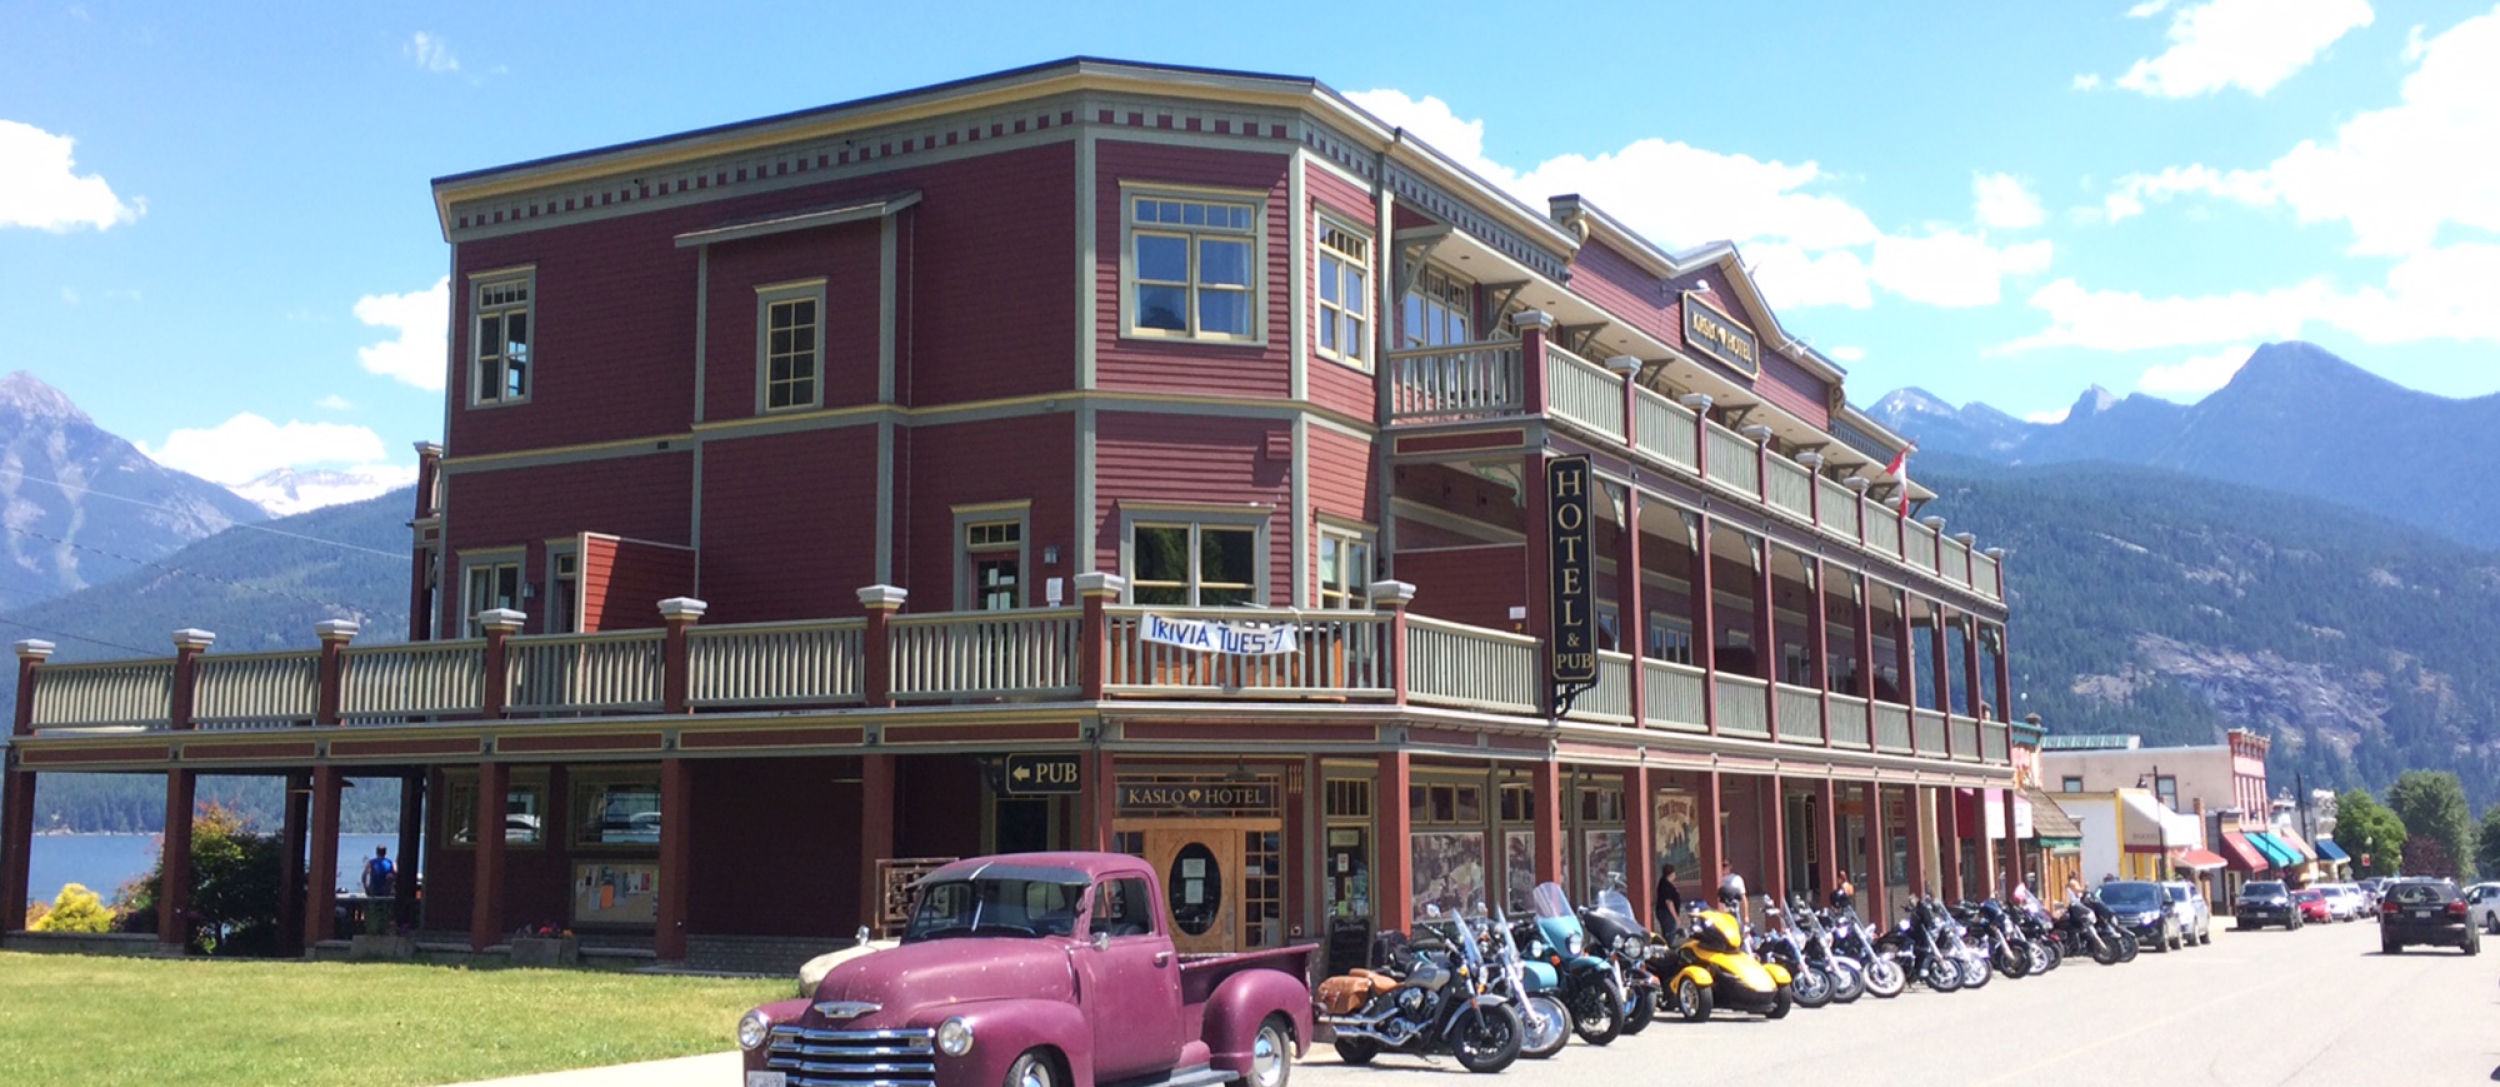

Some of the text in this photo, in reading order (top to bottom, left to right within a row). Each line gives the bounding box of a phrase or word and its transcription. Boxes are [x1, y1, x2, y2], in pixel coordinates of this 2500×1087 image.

[1556, 469, 1583, 627] HOTEL
[1150, 615, 1210, 648] TRIVIA
[1566, 632, 1580, 648] &
[1556, 652, 1593, 669] PUB
[1035, 762, 1078, 783] PUB
[1128, 787, 1265, 804] KASLO HOTEL
